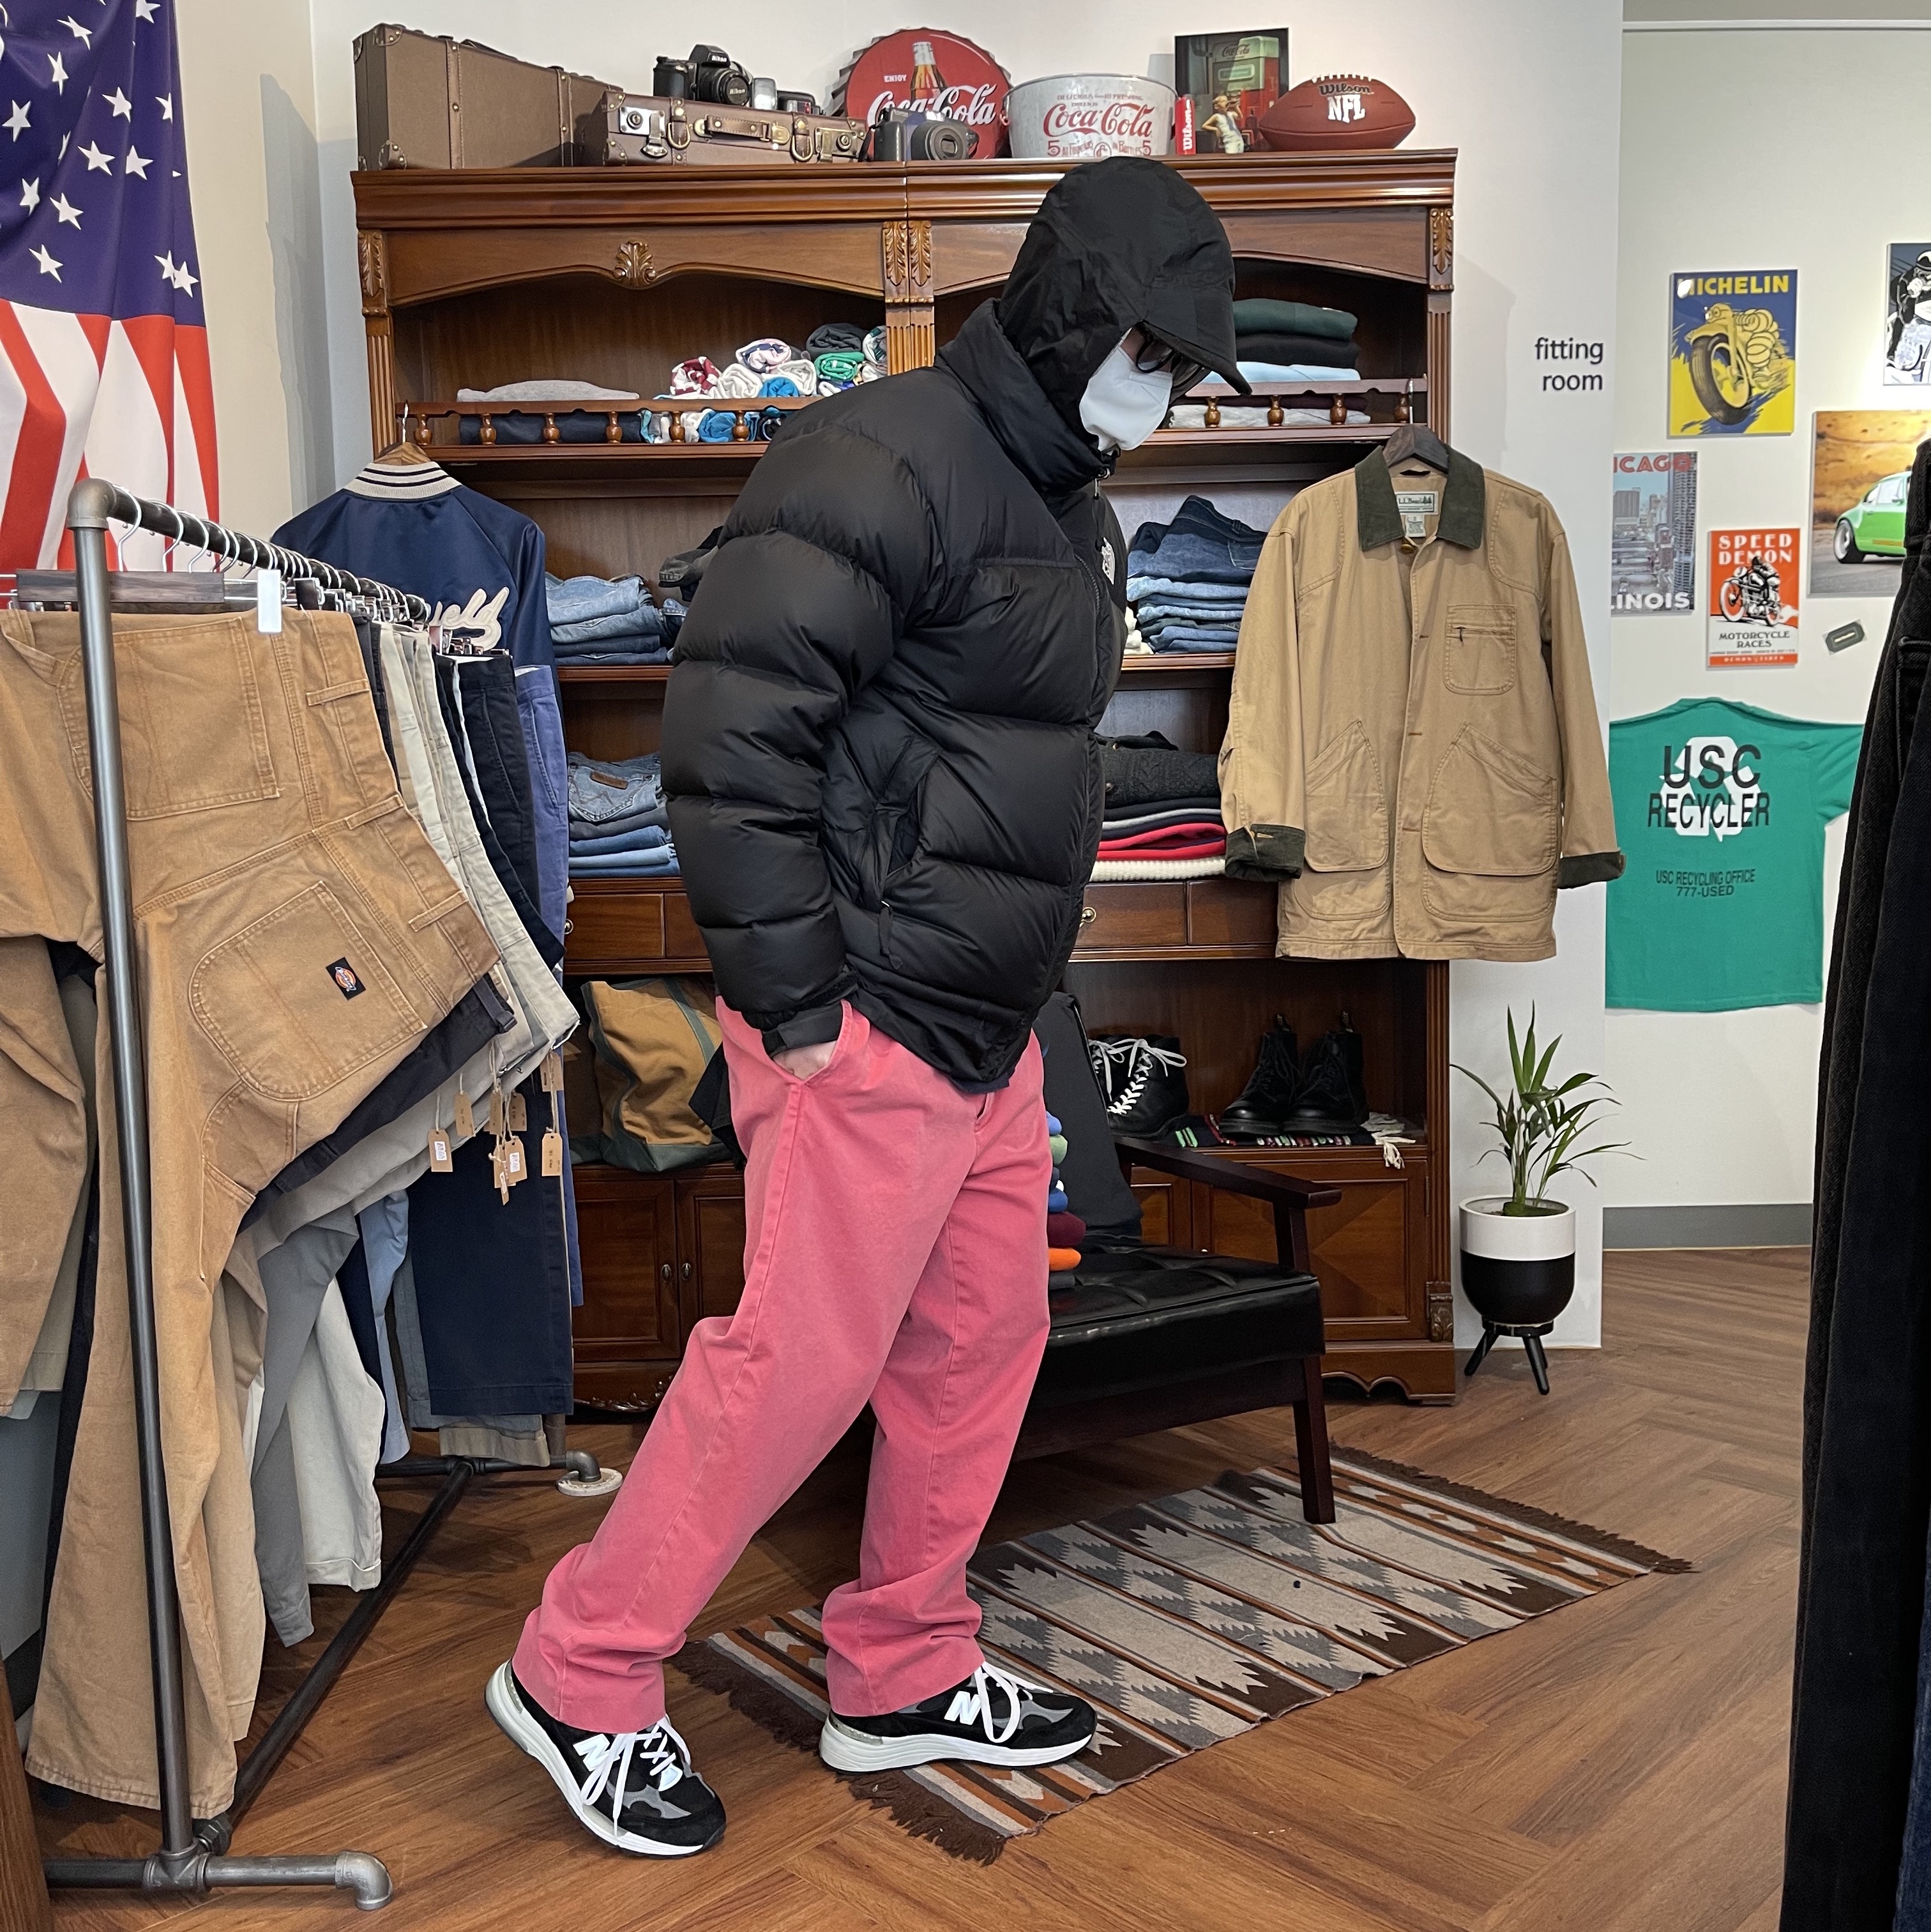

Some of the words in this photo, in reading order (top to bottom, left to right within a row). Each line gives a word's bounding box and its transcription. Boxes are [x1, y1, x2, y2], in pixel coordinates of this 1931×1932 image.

[884, 74, 907, 82] ENJOY
[1318, 83, 1372, 95] Wilson
[1327, 94, 1366, 123] NFL
[1043, 103, 1155, 137] Coca-Cola
[1182, 98, 1193, 151] Wilson
[1534, 337, 1604, 365] fitting
[1543, 374, 1603, 391] room
[1718, 533, 1792, 549] SPEED
[1718, 549, 1792, 565] DEMON
[1610, 591, 1690, 610] INOIS
[1718, 630, 1791, 641] MOTORCYCLE
[1737, 640, 1773, 648] RACES
[1663, 745, 1761, 789] USC
[1647, 793, 1770, 828] RECYCLER
[1656, 870, 1674, 885] USC
[1676, 871, 1723, 886] RECYCLING
[1725, 869, 1756, 884] OFFICE
[1676, 885, 1734, 897] 777-USED
[944, 1691, 981, 1725] N
